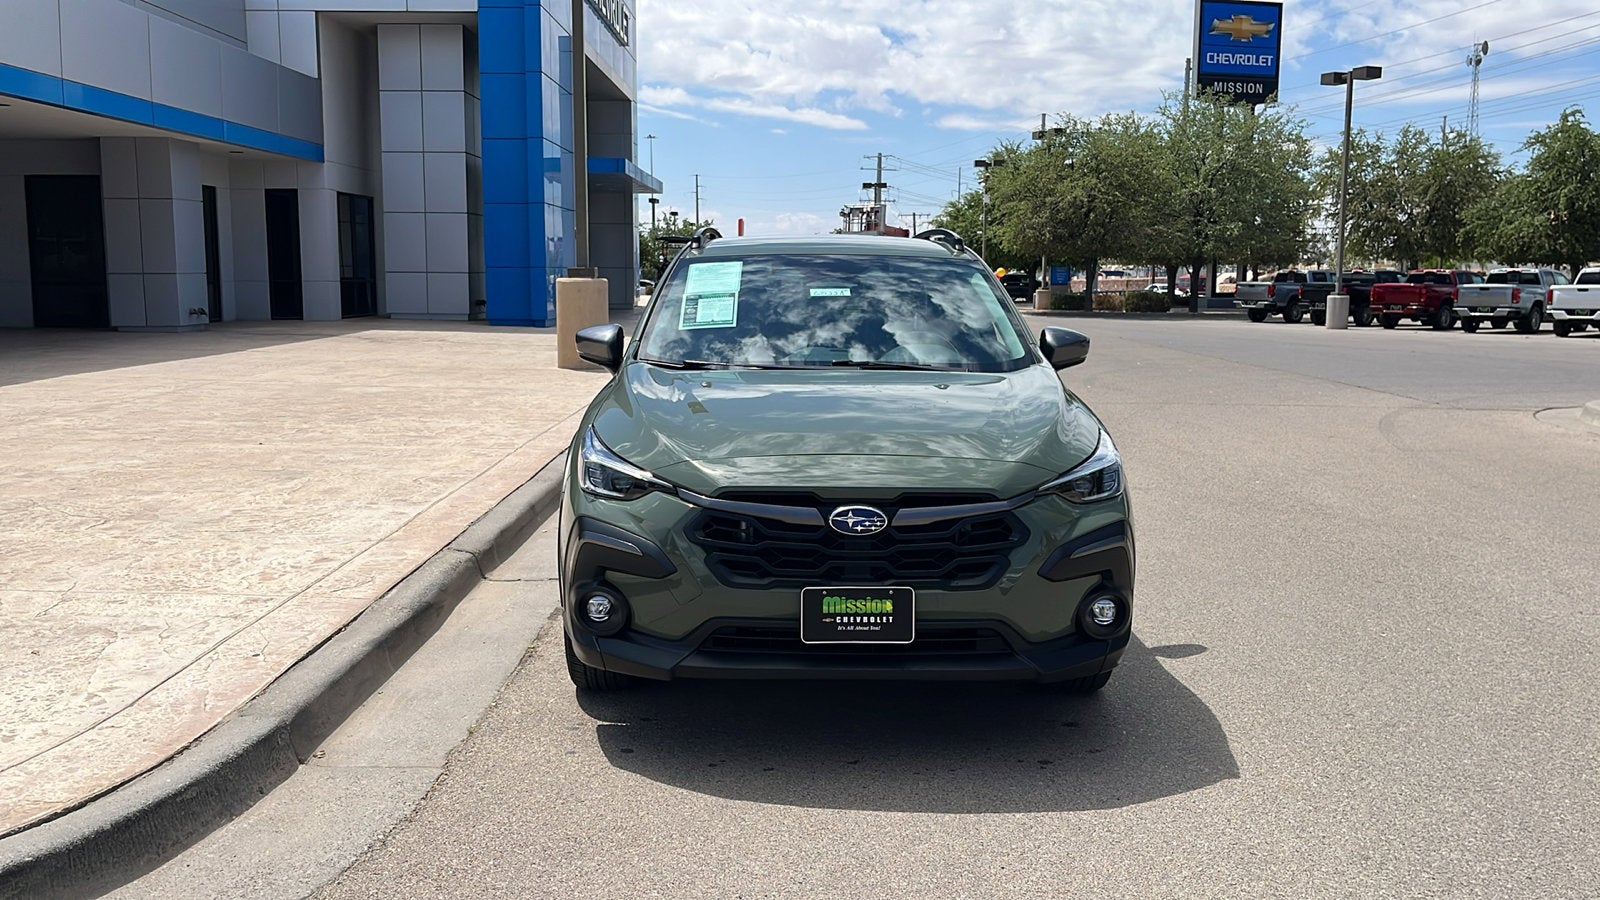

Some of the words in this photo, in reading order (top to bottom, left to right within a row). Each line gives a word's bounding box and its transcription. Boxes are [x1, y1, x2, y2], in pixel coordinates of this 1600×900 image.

[593, 0, 631, 44] ROLET
[1206, 52, 1274, 67] CHEVROLET
[1213, 81, 1263, 94] MISSION
[822, 596, 894, 614] Mission
